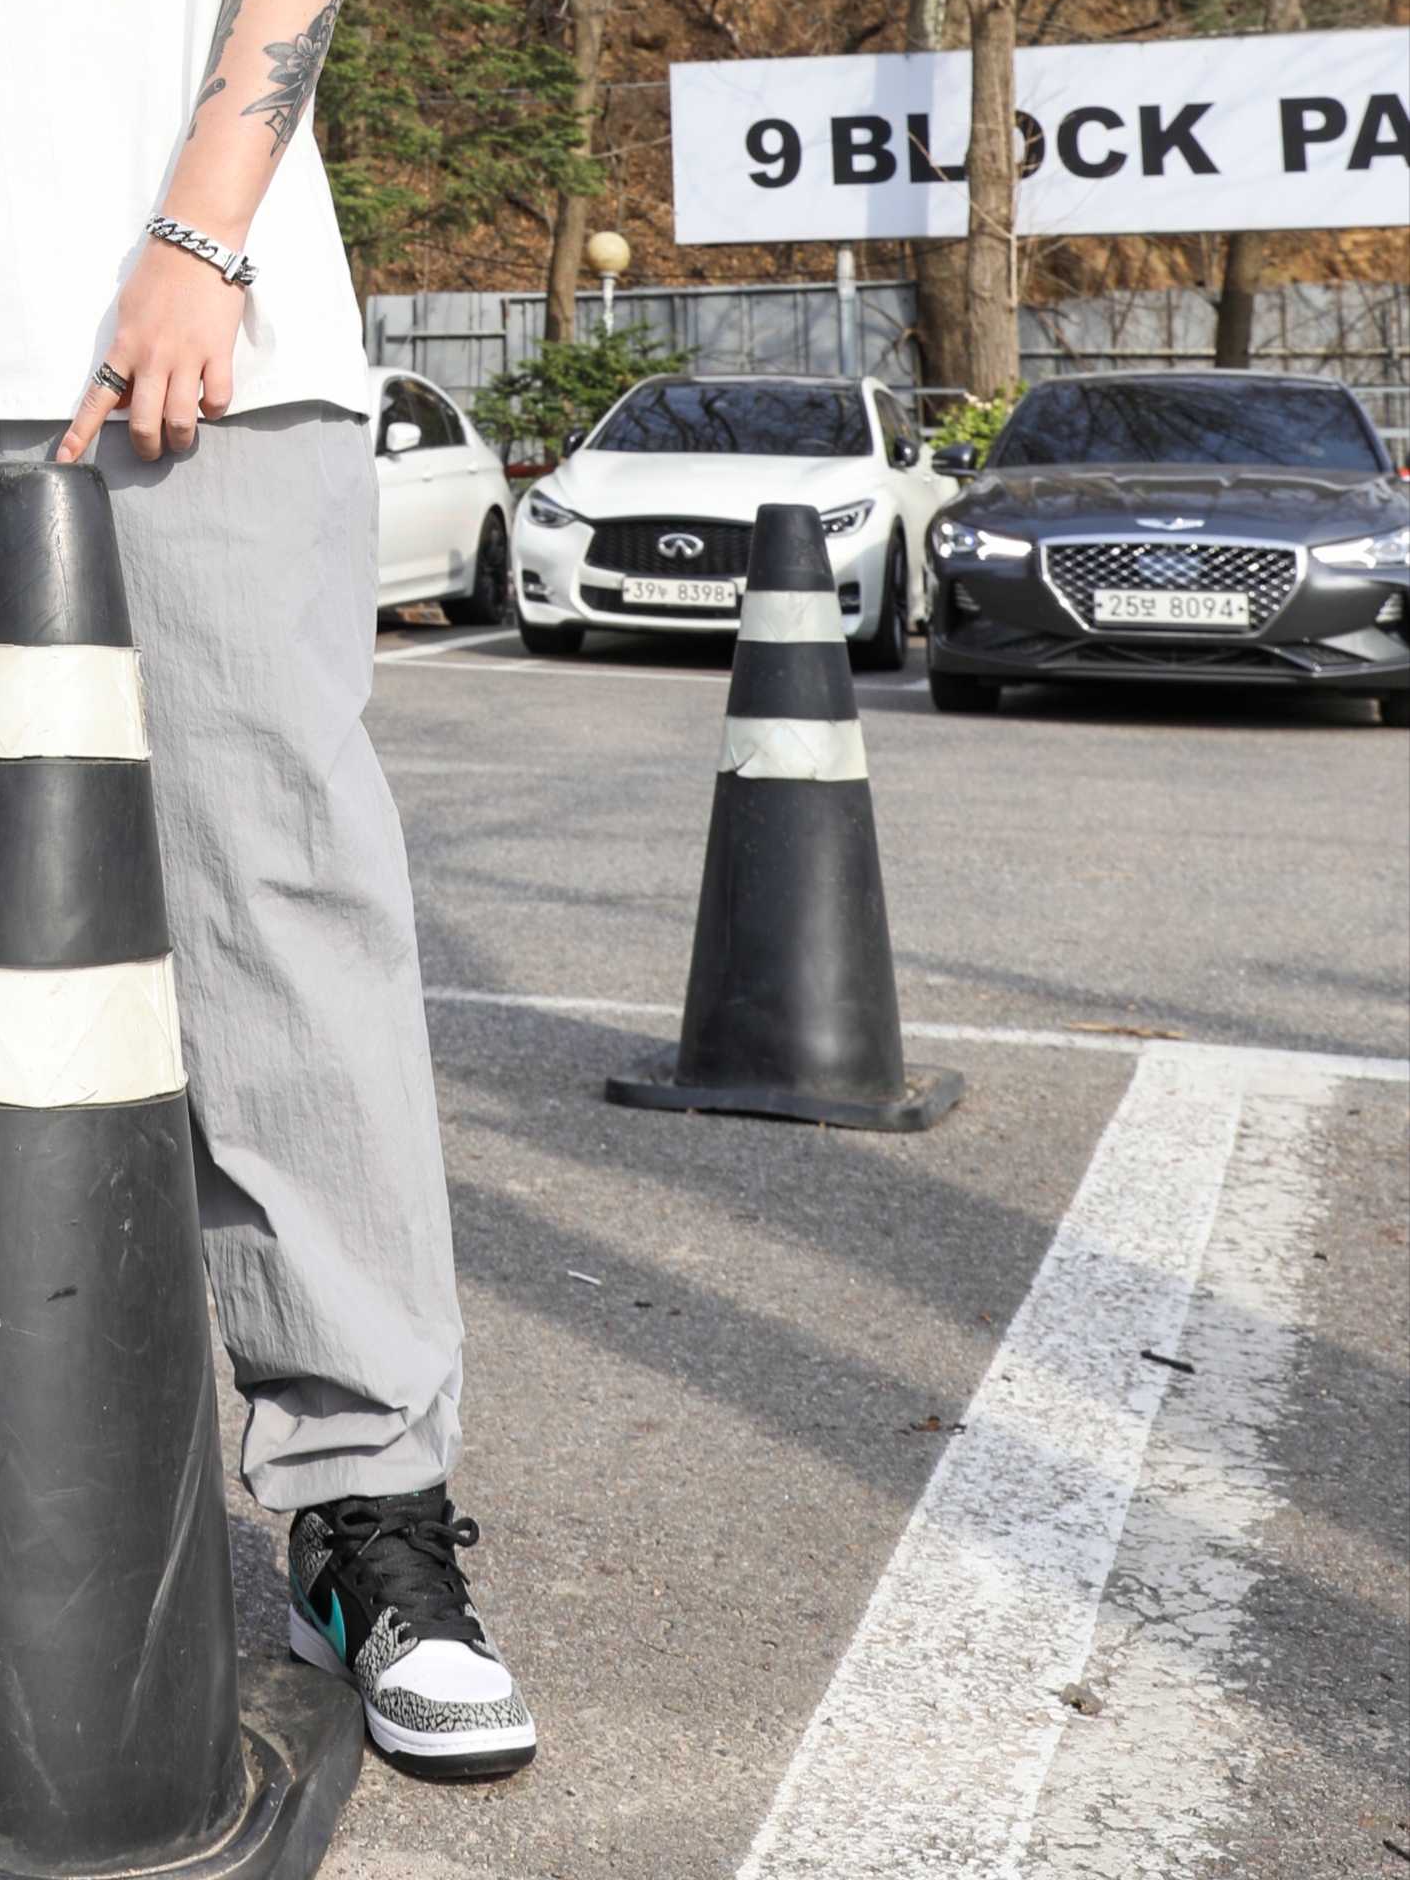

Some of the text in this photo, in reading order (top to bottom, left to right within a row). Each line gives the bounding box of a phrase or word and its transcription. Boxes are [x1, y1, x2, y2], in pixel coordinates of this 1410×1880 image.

[745, 118, 802, 188] 9
[677, 583, 725, 602] 8398
[1170, 596, 1233, 619] 8094
